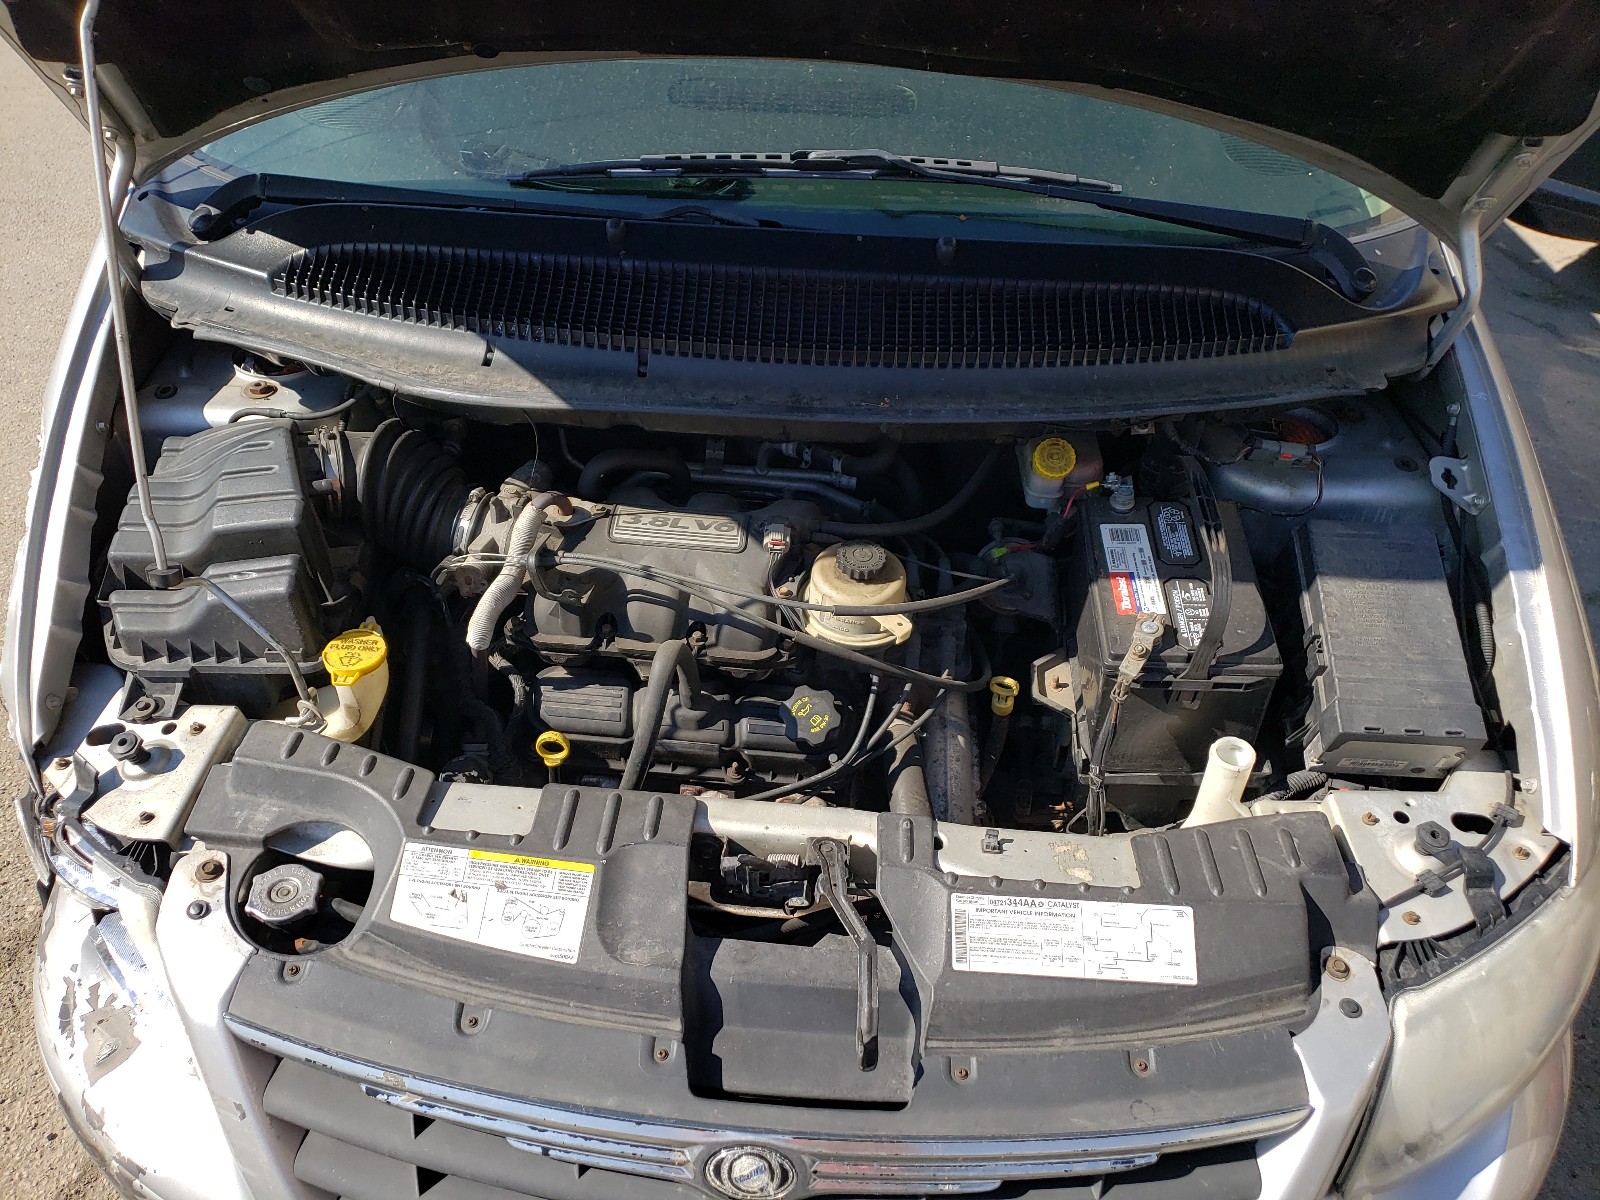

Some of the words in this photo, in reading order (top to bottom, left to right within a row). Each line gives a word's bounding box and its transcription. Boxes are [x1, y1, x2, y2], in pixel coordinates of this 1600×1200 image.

[621, 514, 689, 530] 3.8L
[694, 519, 736, 533] V6
[340, 638, 379, 646] WASHER
[329, 643, 356, 651] FLUID
[357, 645, 382, 653] ONLY
[520, 858, 550, 866] WARNING
[1047, 901, 1080, 909] CATALYST
